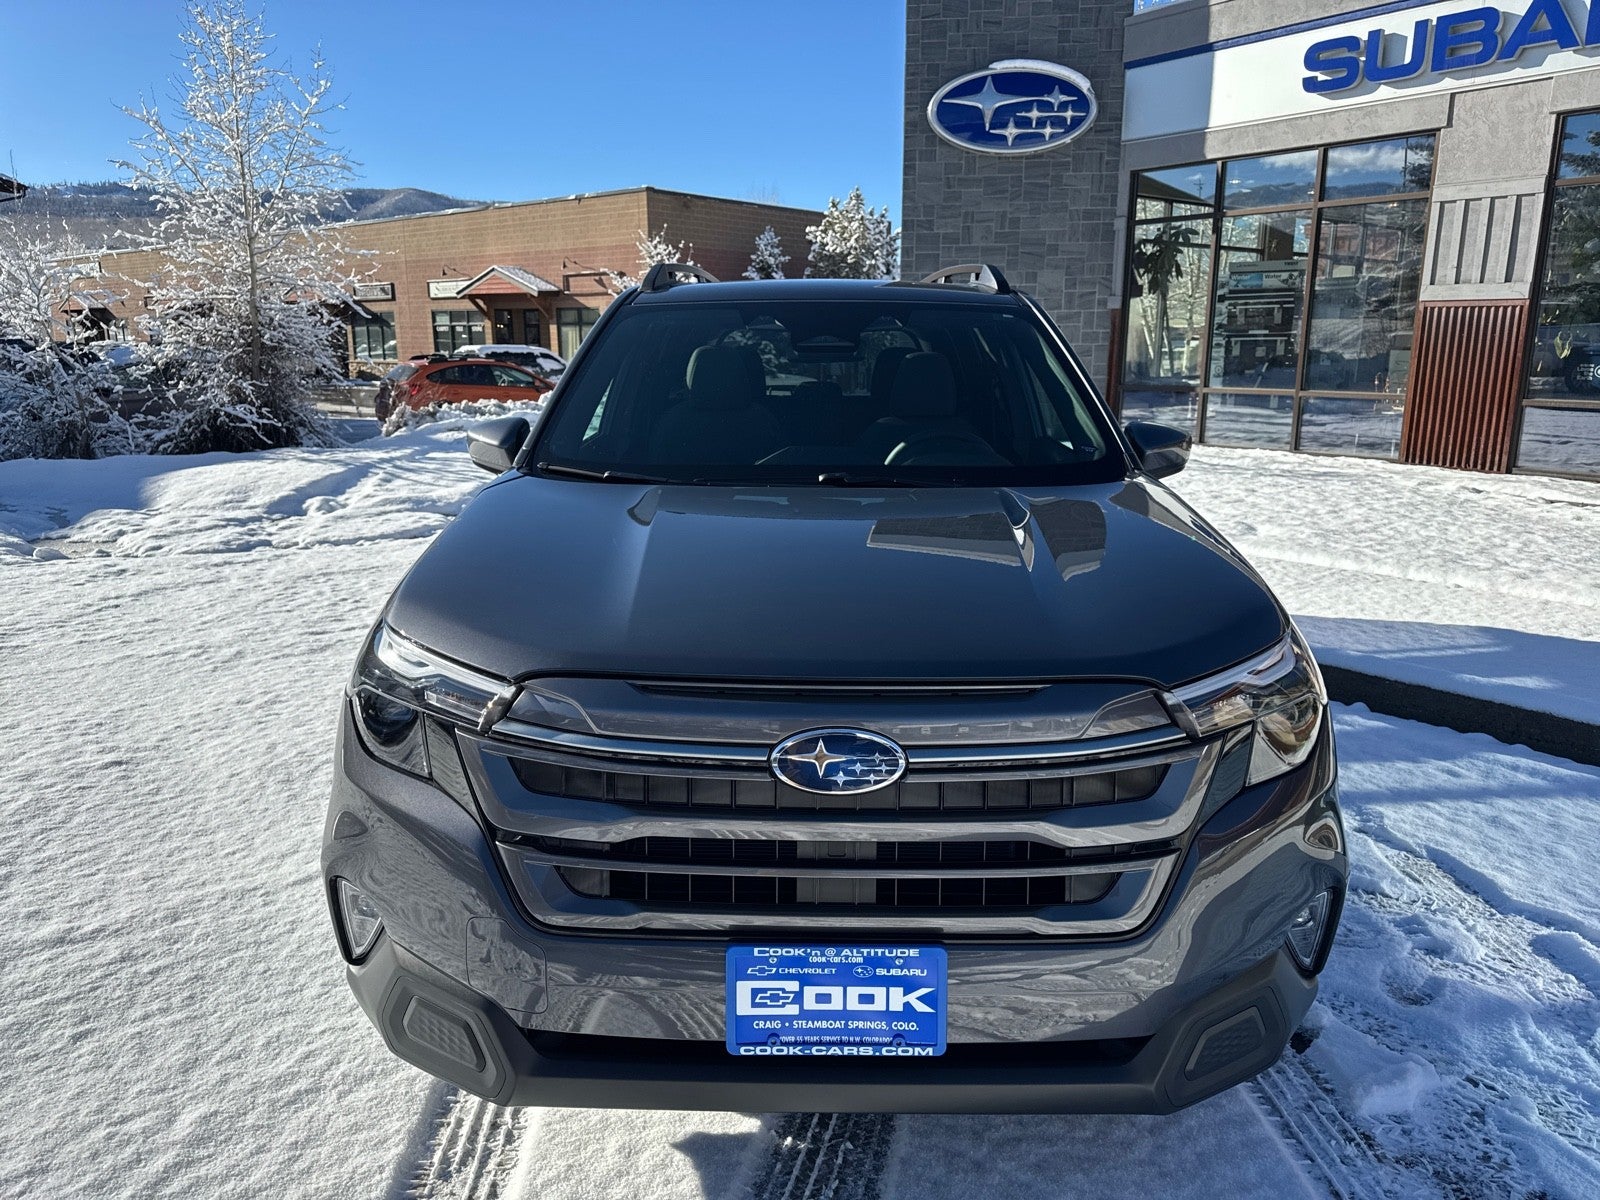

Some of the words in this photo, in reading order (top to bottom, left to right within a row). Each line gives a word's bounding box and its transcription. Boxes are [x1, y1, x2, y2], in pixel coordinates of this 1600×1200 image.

[1302, 0, 1600, 93] SUBA
[824, 947, 837, 957] @
[840, 948, 920, 957] ALTITUDE
[808, 956, 864, 964] cook-cars.com
[778, 967, 837, 975] CHEVROLET
[875, 968, 927, 977] SUBARU
[736, 980, 937, 1016] COOK
[753, 1020, 782, 1029] CRAIG
[792, 1020, 846, 1029] STEAMBOAT
[847, 1020, 890, 1031] SPRINGS,
[891, 1021, 920, 1031] COLO.
[739, 1046, 934, 1056] COOK-CARS.COM
